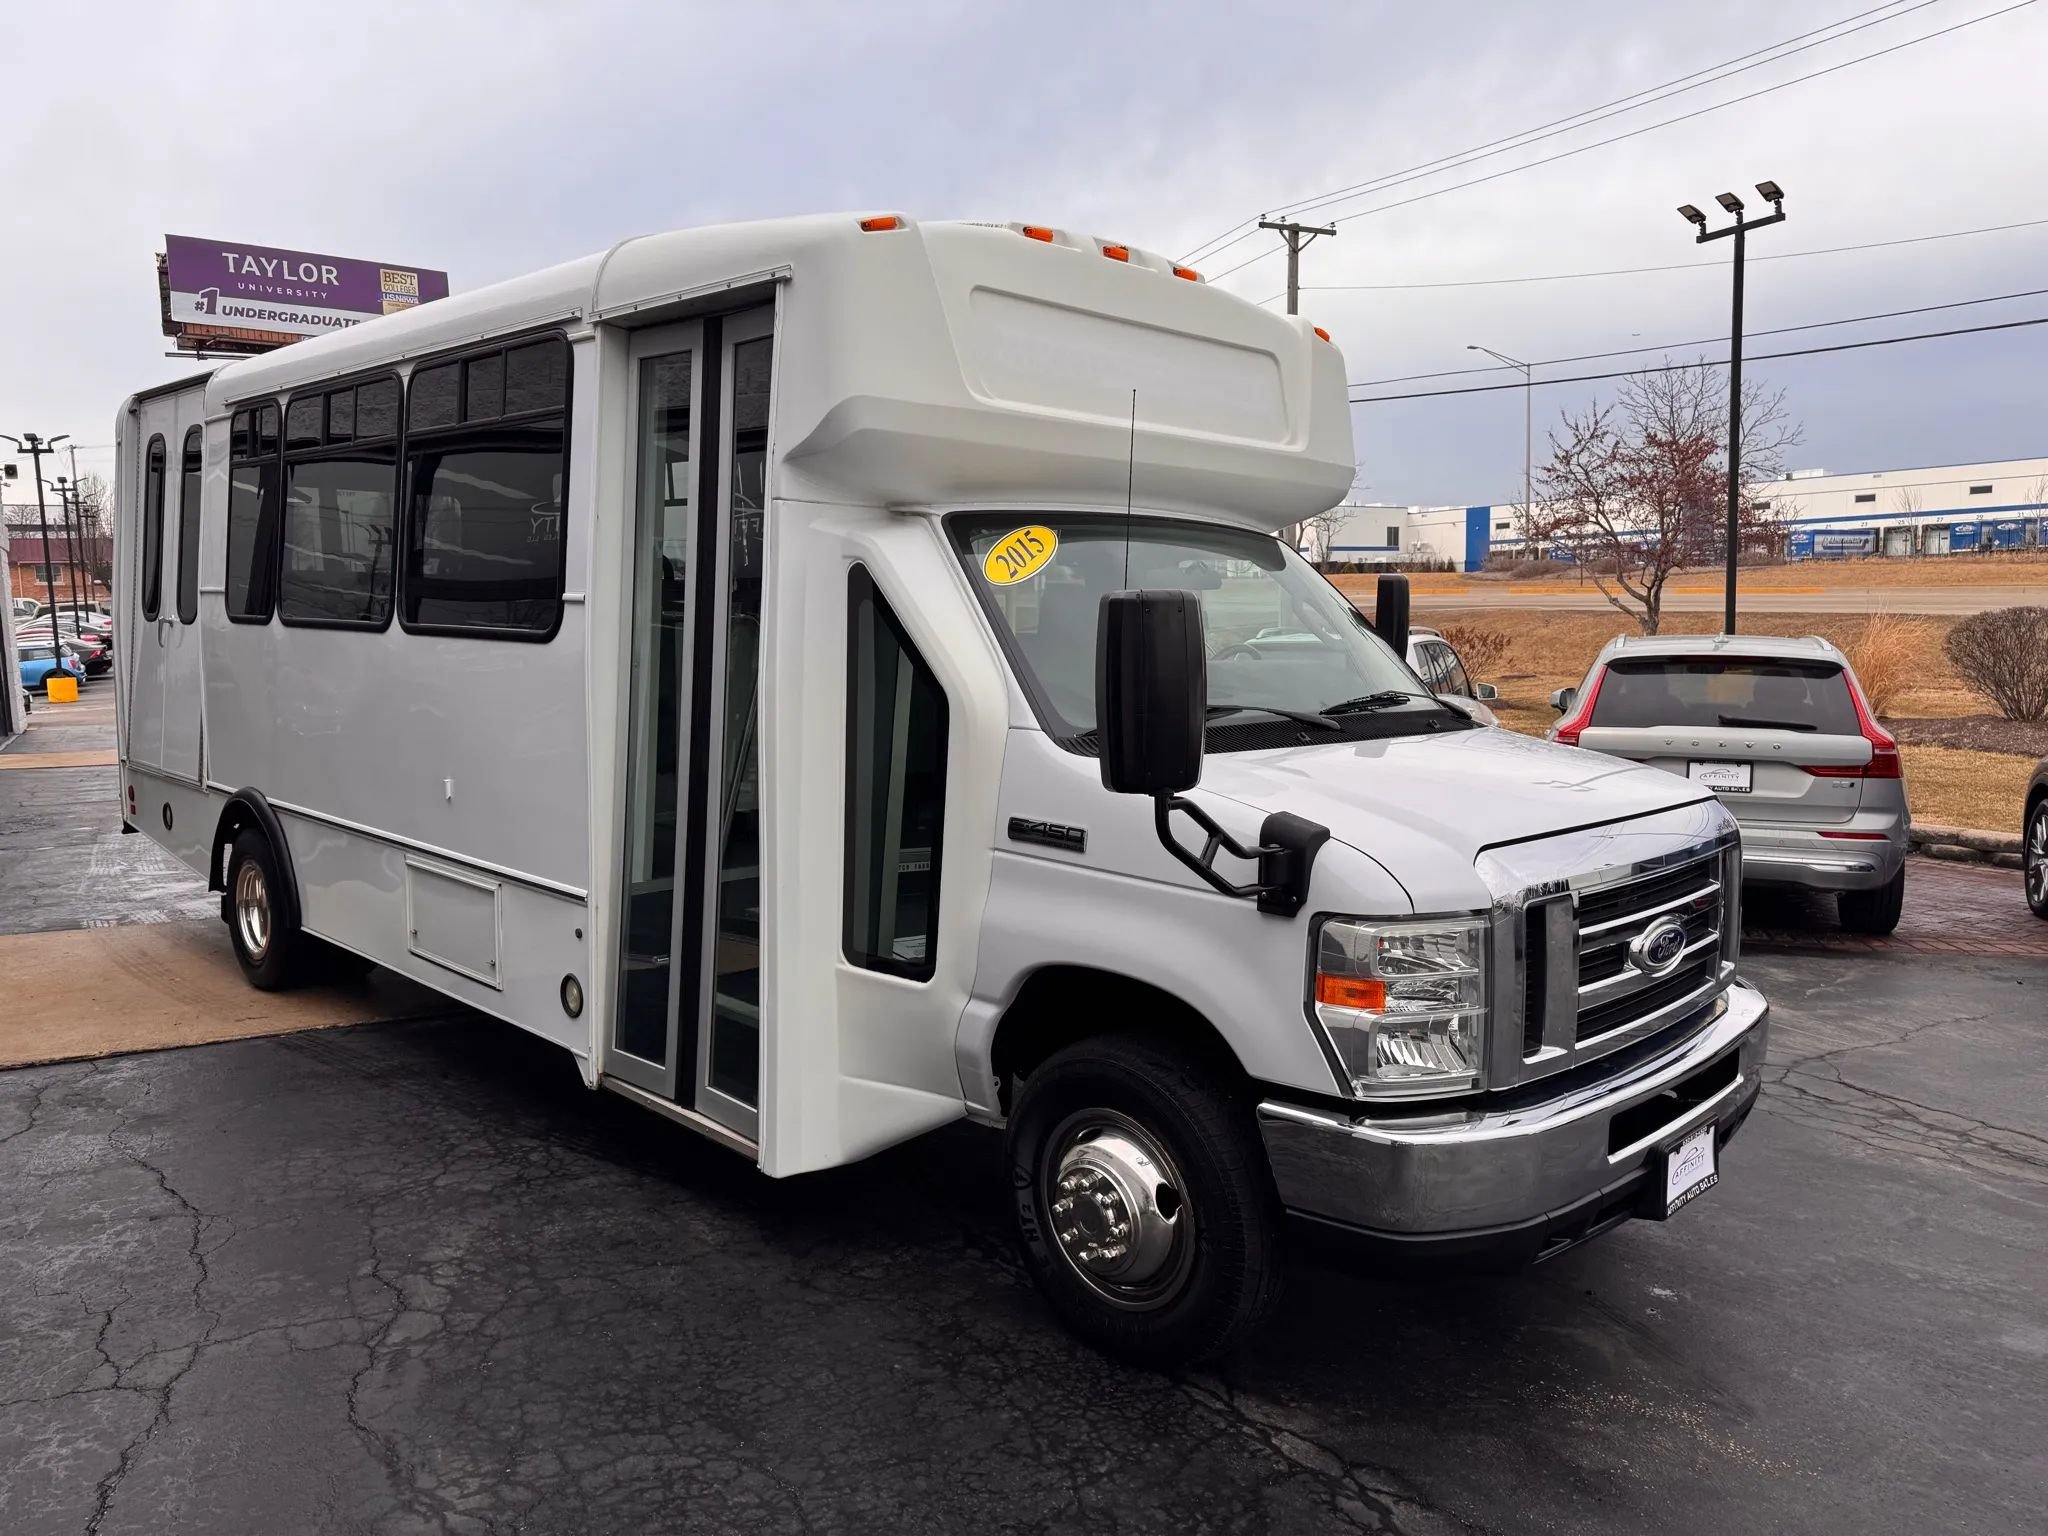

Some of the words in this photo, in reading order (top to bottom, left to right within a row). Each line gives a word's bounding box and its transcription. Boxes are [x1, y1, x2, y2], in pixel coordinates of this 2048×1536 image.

[221, 252, 340, 286] TAYLOR
[383, 271, 416, 286] BEST
[194, 287, 220, 315] #1
[237, 282, 328, 299] UNIVERSITY
[383, 283, 417, 295] COLLEGES
[995, 530, 1045, 579] 2015
[1664, 738, 1781, 750] VOLVO
[1657, 932, 1681, 959] Ford
[1675, 1154, 1704, 1178] AFFINITY
[1667, 1193, 1687, 1217] AFFINITY
[1687, 1186, 1700, 1201] AUTO
[1700, 1174, 1718, 1191] SALES
